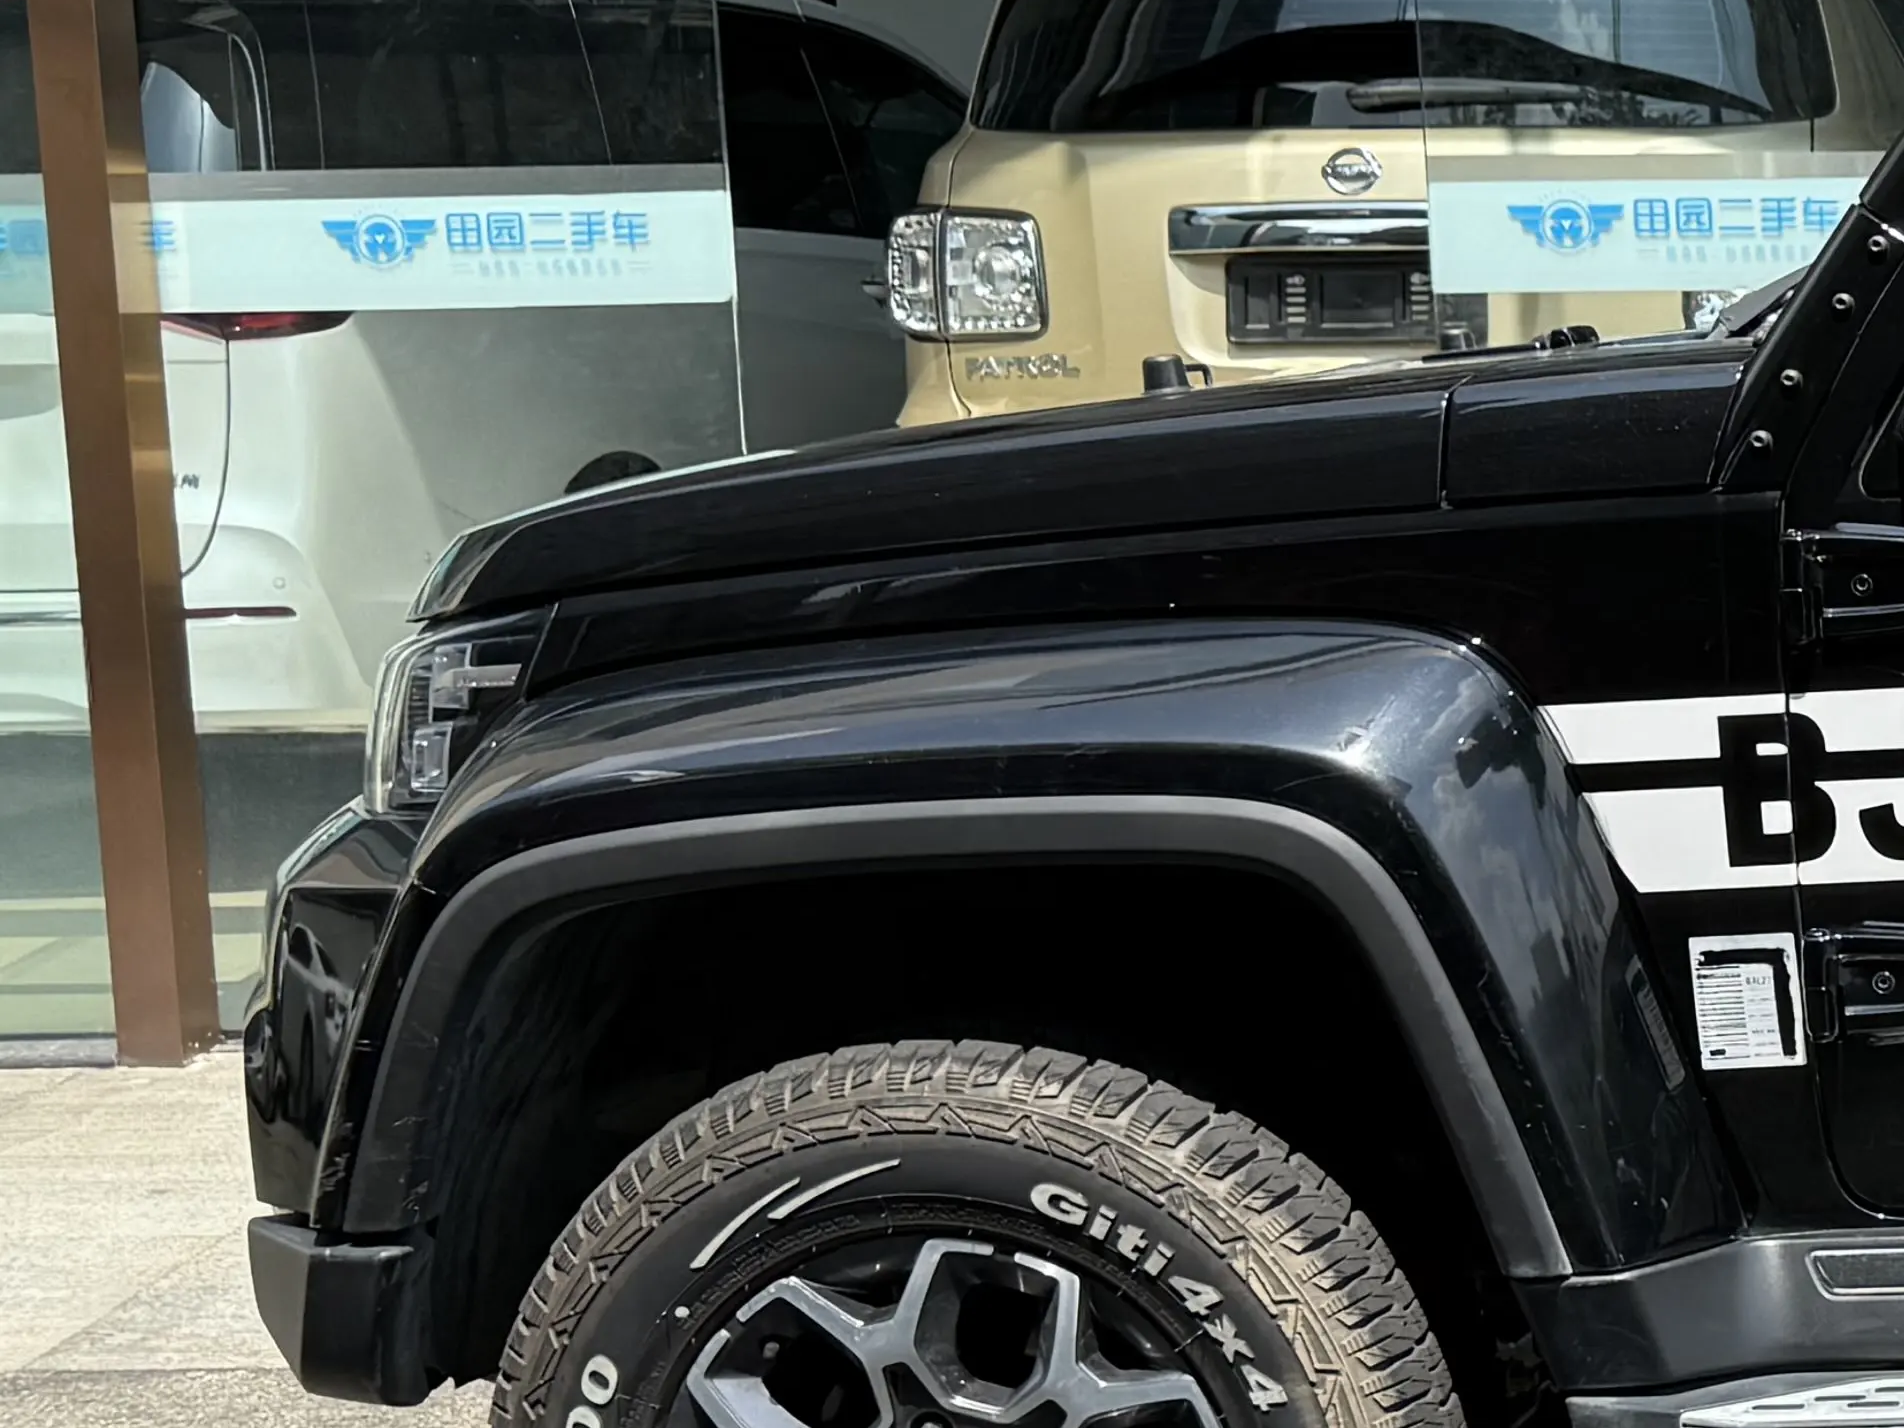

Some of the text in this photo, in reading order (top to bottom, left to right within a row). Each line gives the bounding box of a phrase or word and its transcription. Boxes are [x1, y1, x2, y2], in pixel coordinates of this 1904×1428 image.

[444, 209, 651, 253] 田园二手车
[1633, 196, 1840, 238] 田园二手车
[964, 353, 1081, 381] PATROL
